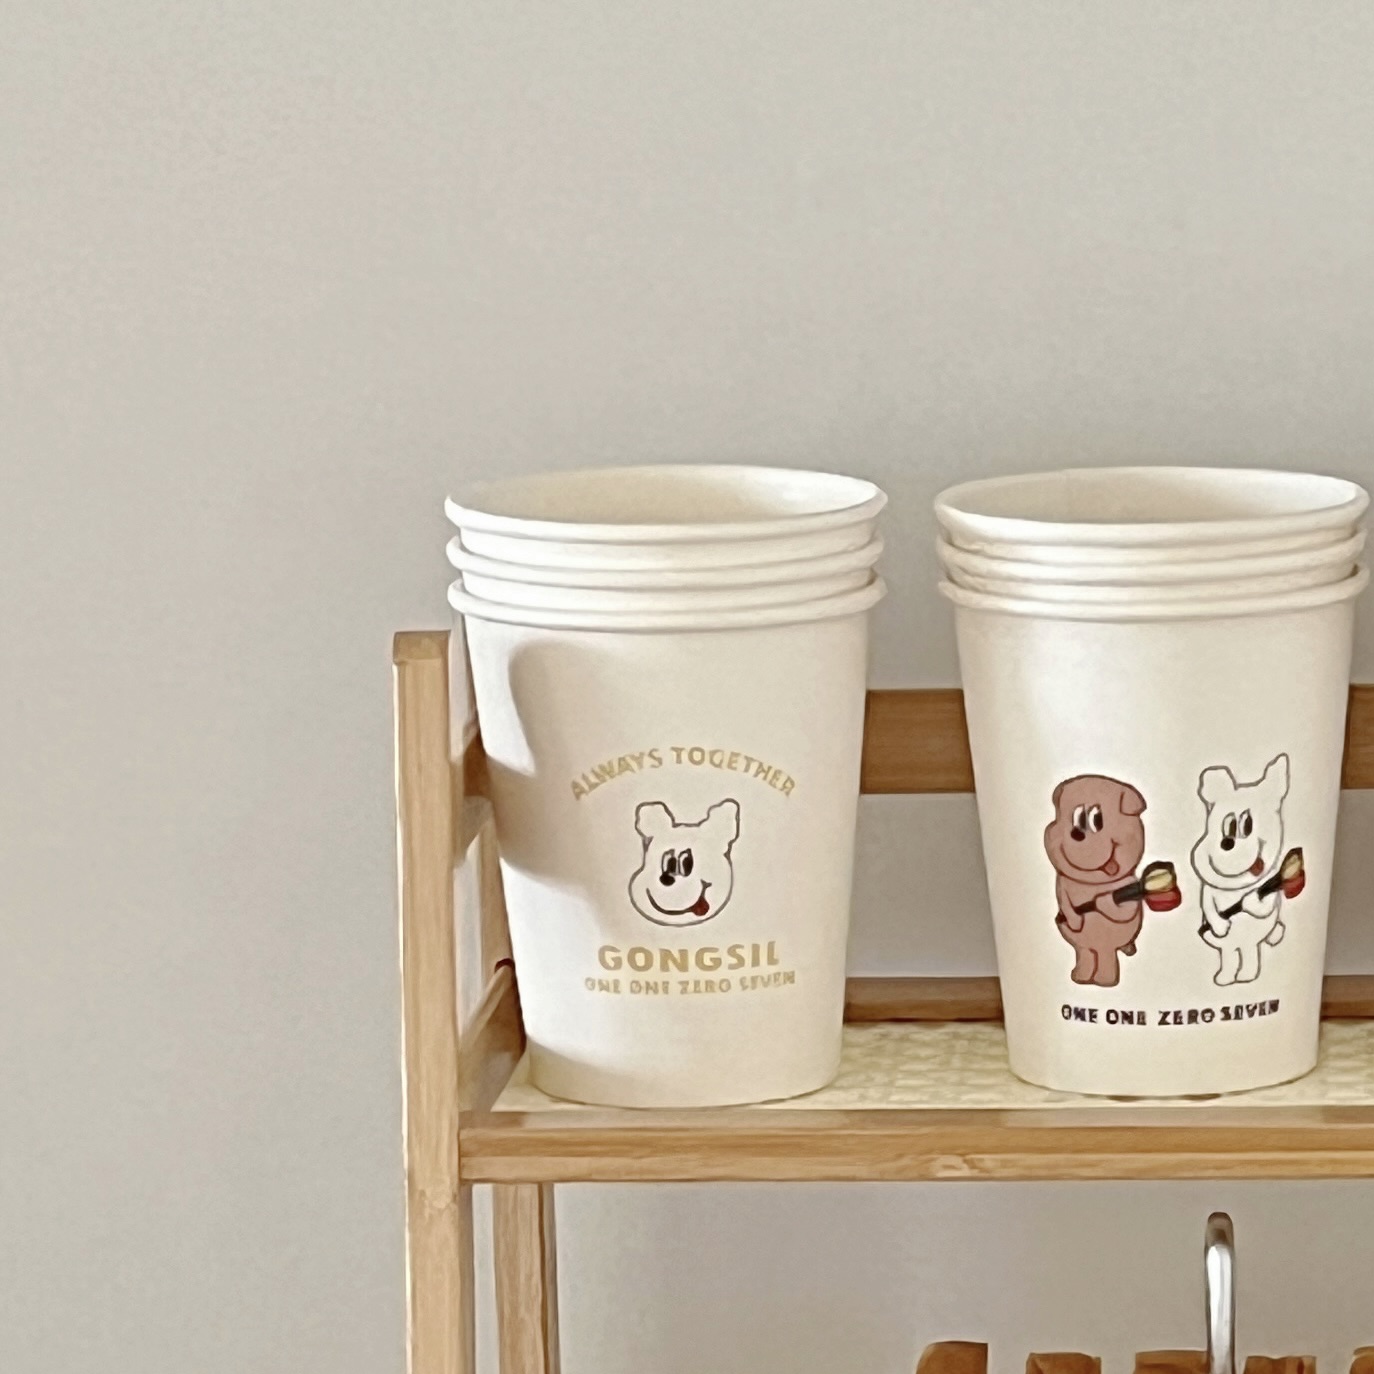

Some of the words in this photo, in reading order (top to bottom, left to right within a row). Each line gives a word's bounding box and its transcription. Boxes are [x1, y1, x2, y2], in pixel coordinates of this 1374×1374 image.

[570, 748, 664, 801] ALWAYS
[671, 746, 796, 798] TOGETHER
[597, 941, 780, 974] GONGSIL
[678, 977, 732, 996] ZERO
[1061, 1003, 1099, 1023] ONE
[1105, 1008, 1147, 1026] ONE
[1157, 1007, 1216, 1026] ZERO
